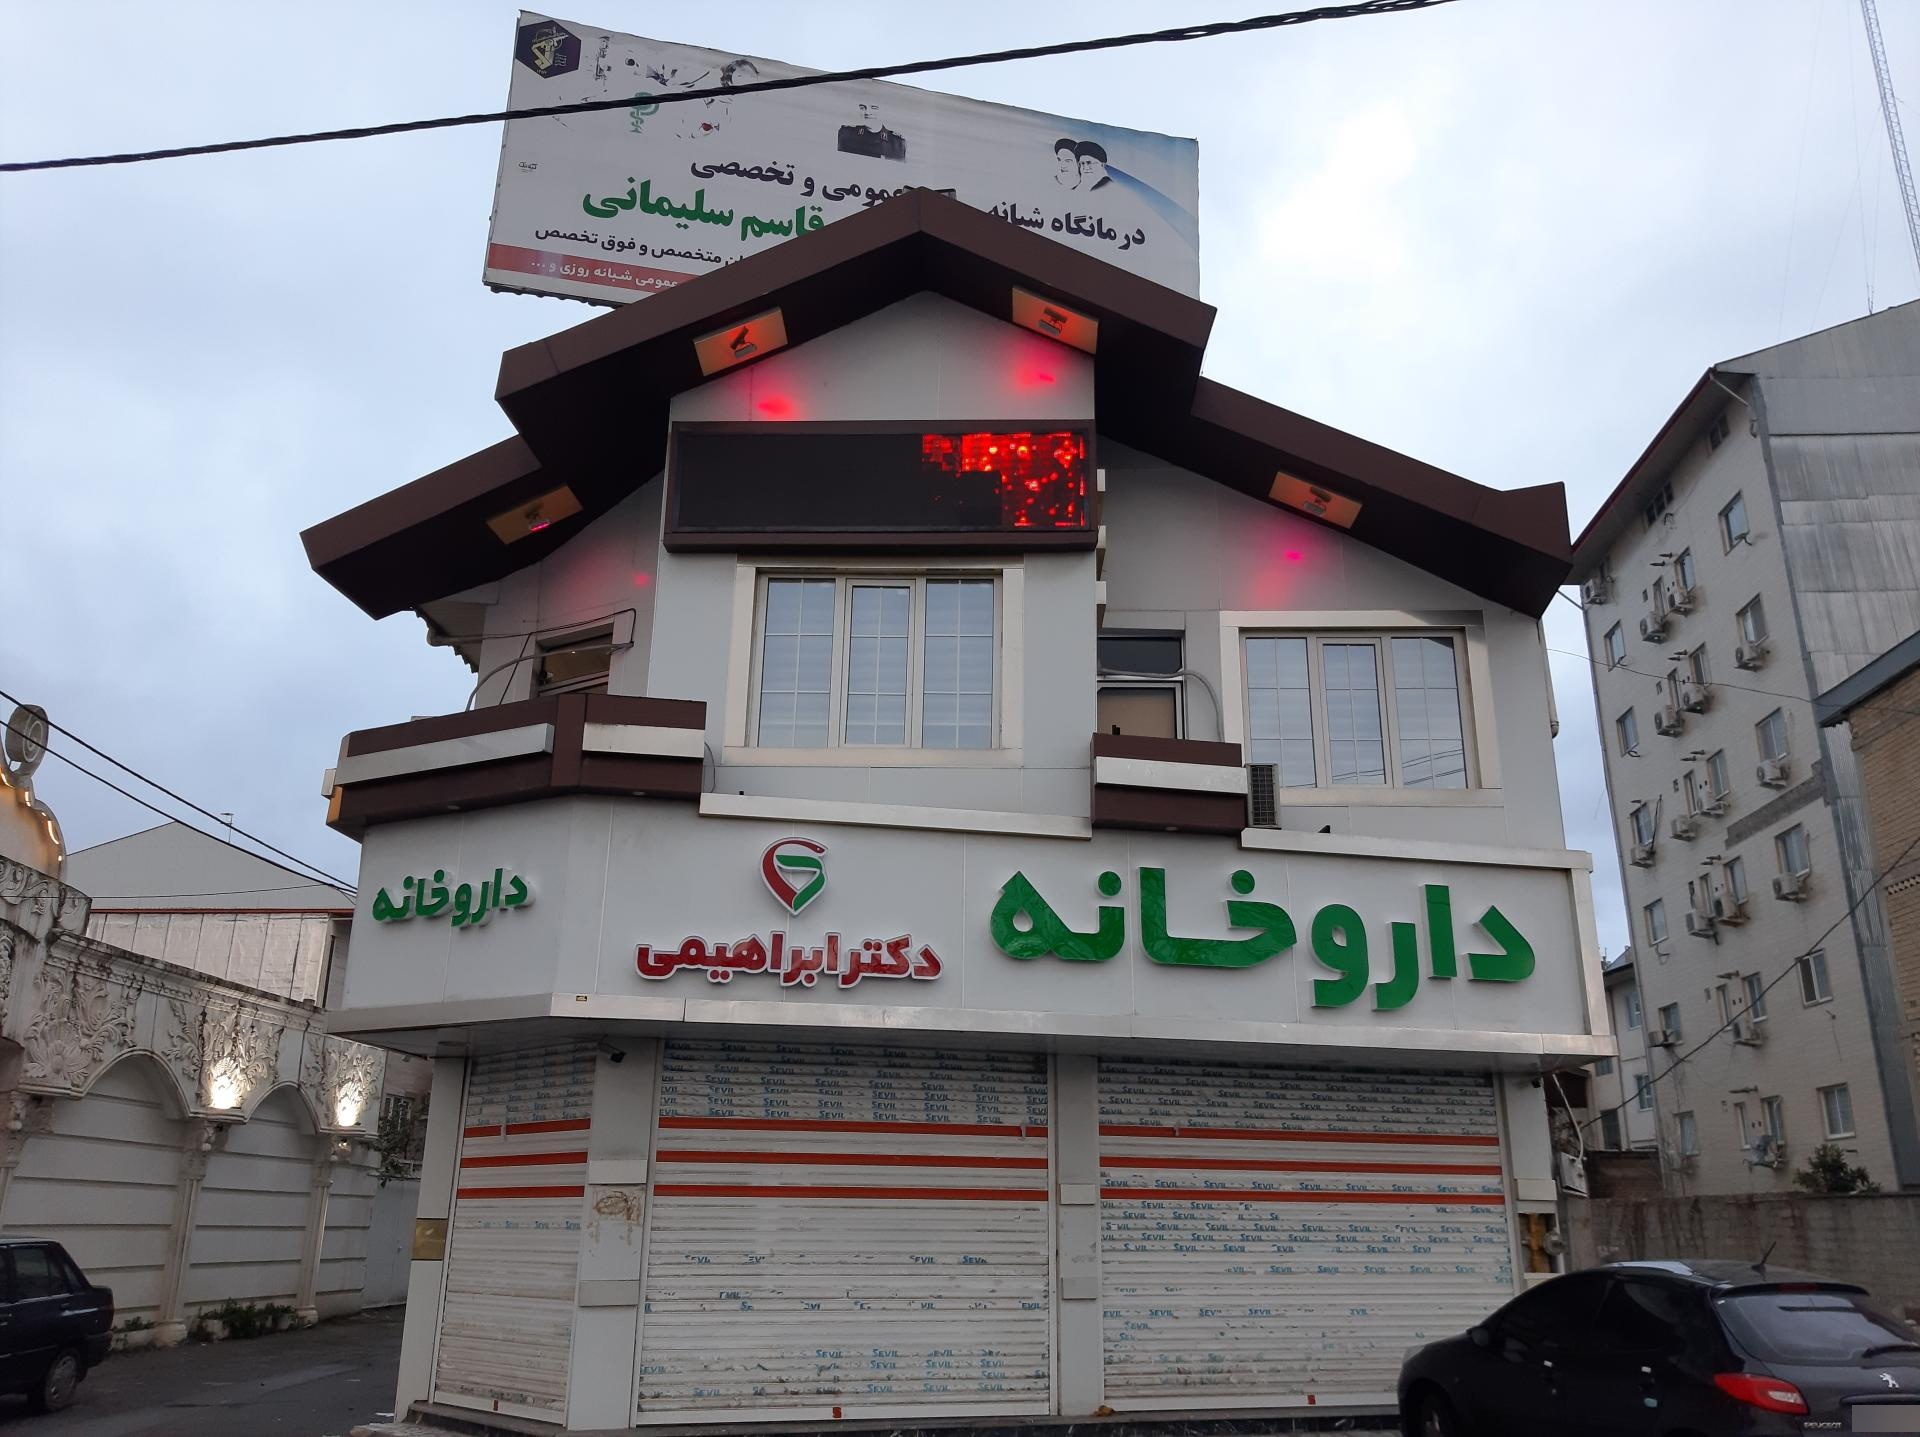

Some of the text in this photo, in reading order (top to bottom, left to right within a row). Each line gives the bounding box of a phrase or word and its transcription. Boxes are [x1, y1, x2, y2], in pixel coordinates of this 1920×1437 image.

[690, 160, 795, 186] تخصصی
[800, 175, 815, 196] و
[583, 176, 825, 242] قاسم سلیمانی
[535, 228, 598, 244] تخصص
[1051, 212, 1146, 250] درمانگاه
[601, 235, 636, 251] فوق
[639, 243, 648, 256] و
[651, 247, 722, 264] متخصص
[549, 262, 556, 273] و
[560, 263, 589, 277] روزی
[594, 265, 633, 281] شبانه
[372, 868, 528, 927] داروخانه
[990, 866, 1536, 1011] داروخانه
[635, 930, 944, 988] دکتر ابراهیمی
